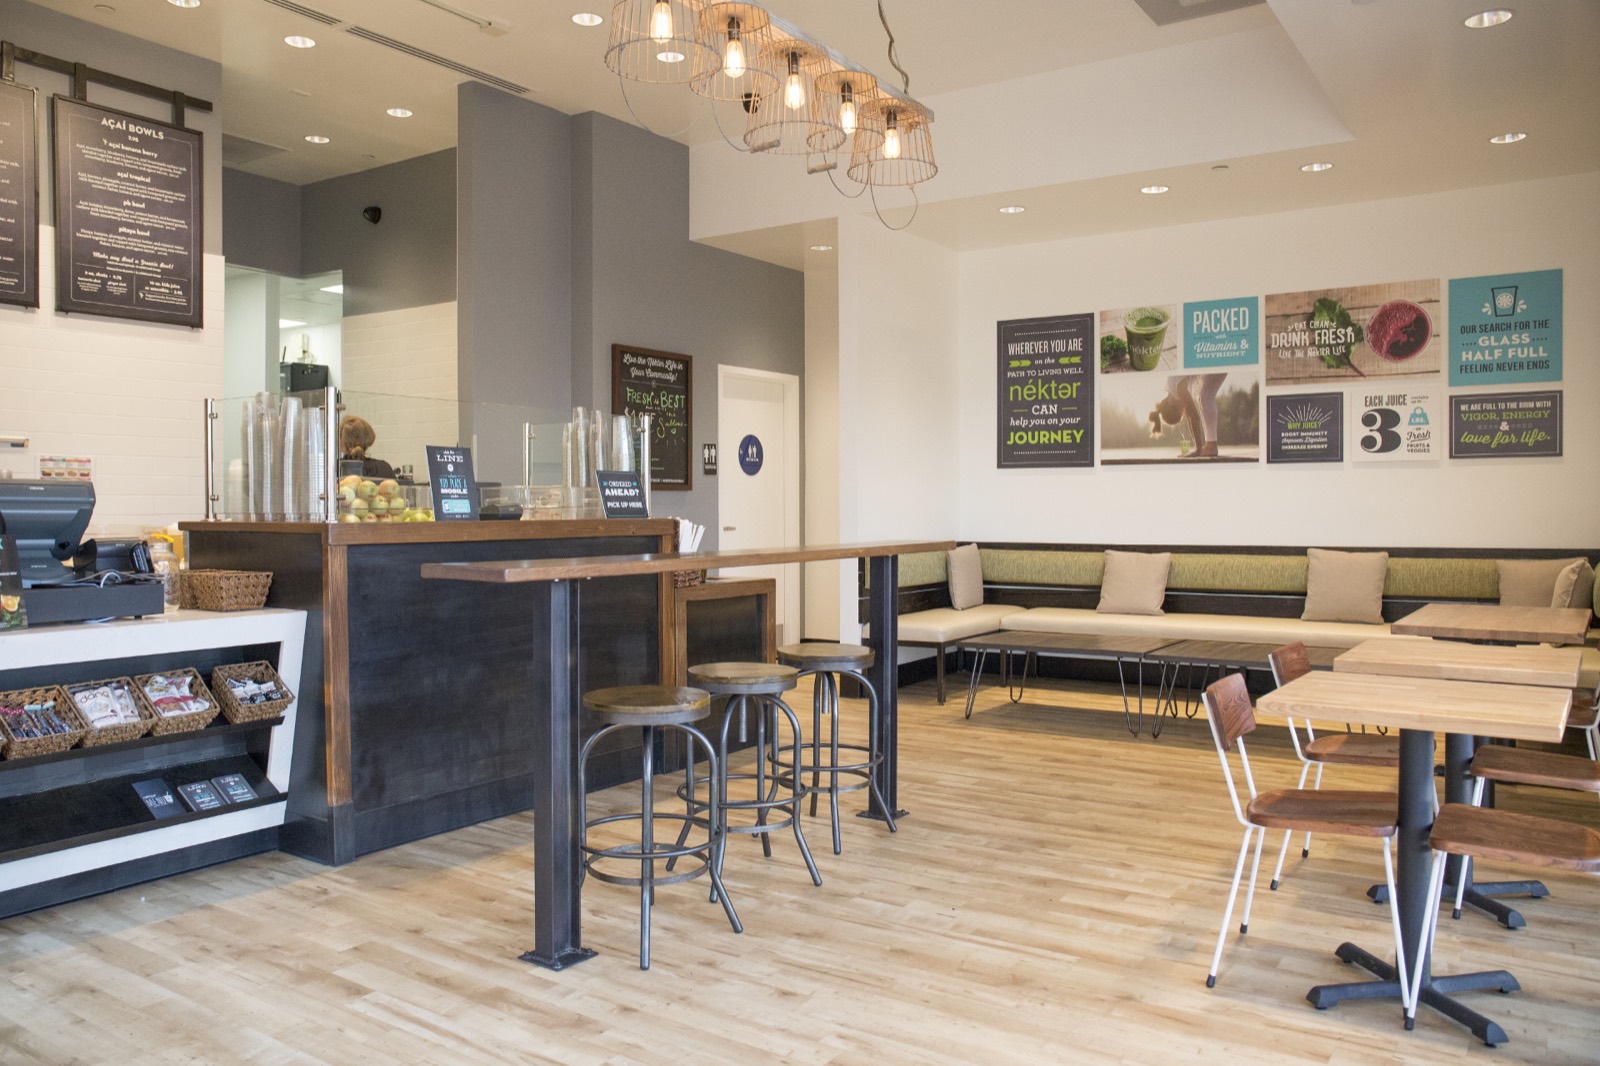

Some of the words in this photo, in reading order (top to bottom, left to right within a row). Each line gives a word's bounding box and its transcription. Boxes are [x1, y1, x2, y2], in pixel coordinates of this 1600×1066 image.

[129, 124, 164, 139] BOWLS
[122, 143, 141, 154] banana
[142, 149, 157, 158] berry
[130, 172, 150, 183] tropical
[1193, 307, 1249, 334] PACKED
[1295, 321, 1306, 331] EAT
[1460, 325, 1476, 334] OUR
[1479, 322, 1511, 333] SEARCH
[1514, 321, 1530, 331] FOR
[1533, 319, 1549, 329] THE
[1008, 341, 1049, 355] WHEREVER
[1051, 339, 1066, 353] YOU
[1068, 338, 1083, 351] ARE
[1194, 341, 1238, 352] Vitamins
[1240, 339, 1249, 349] &
[1478, 333, 1530, 346] GLASS
[623, 353, 636, 365] Live
[638, 356, 646, 365] the
[1462, 349, 1502, 361] HALF
[1508, 346, 1548, 359] FULL
[1460, 363, 1493, 374] FEELING
[1496, 361, 1524, 372] NEVER
[1527, 360, 1550, 370] ENDS
[630, 367, 645, 378] Your
[646, 368, 678, 383] Community!
[627, 386, 654, 405] FRESH
[661, 391, 685, 408] BEST
[1365, 395, 1383, 407] EACH
[1385, 394, 1407, 406] JUICE
[1032, 404, 1058, 415] CAN
[1461, 412, 1499, 421] VIGOR,
[1503, 410, 1551, 419] ENERGY
[1010, 417, 1029, 428] help
[1030, 418, 1045, 427] you
[1059, 417, 1081, 427] your
[1500, 421, 1510, 431] &
[1007, 429, 1084, 445] JOURNEY
[1360, 408, 1401, 453] 3
[1407, 430, 1430, 441] Fresh
[1460, 432, 1491, 444] love
[1491, 432, 1518, 448] for
[1521, 429, 1550, 446] life.
